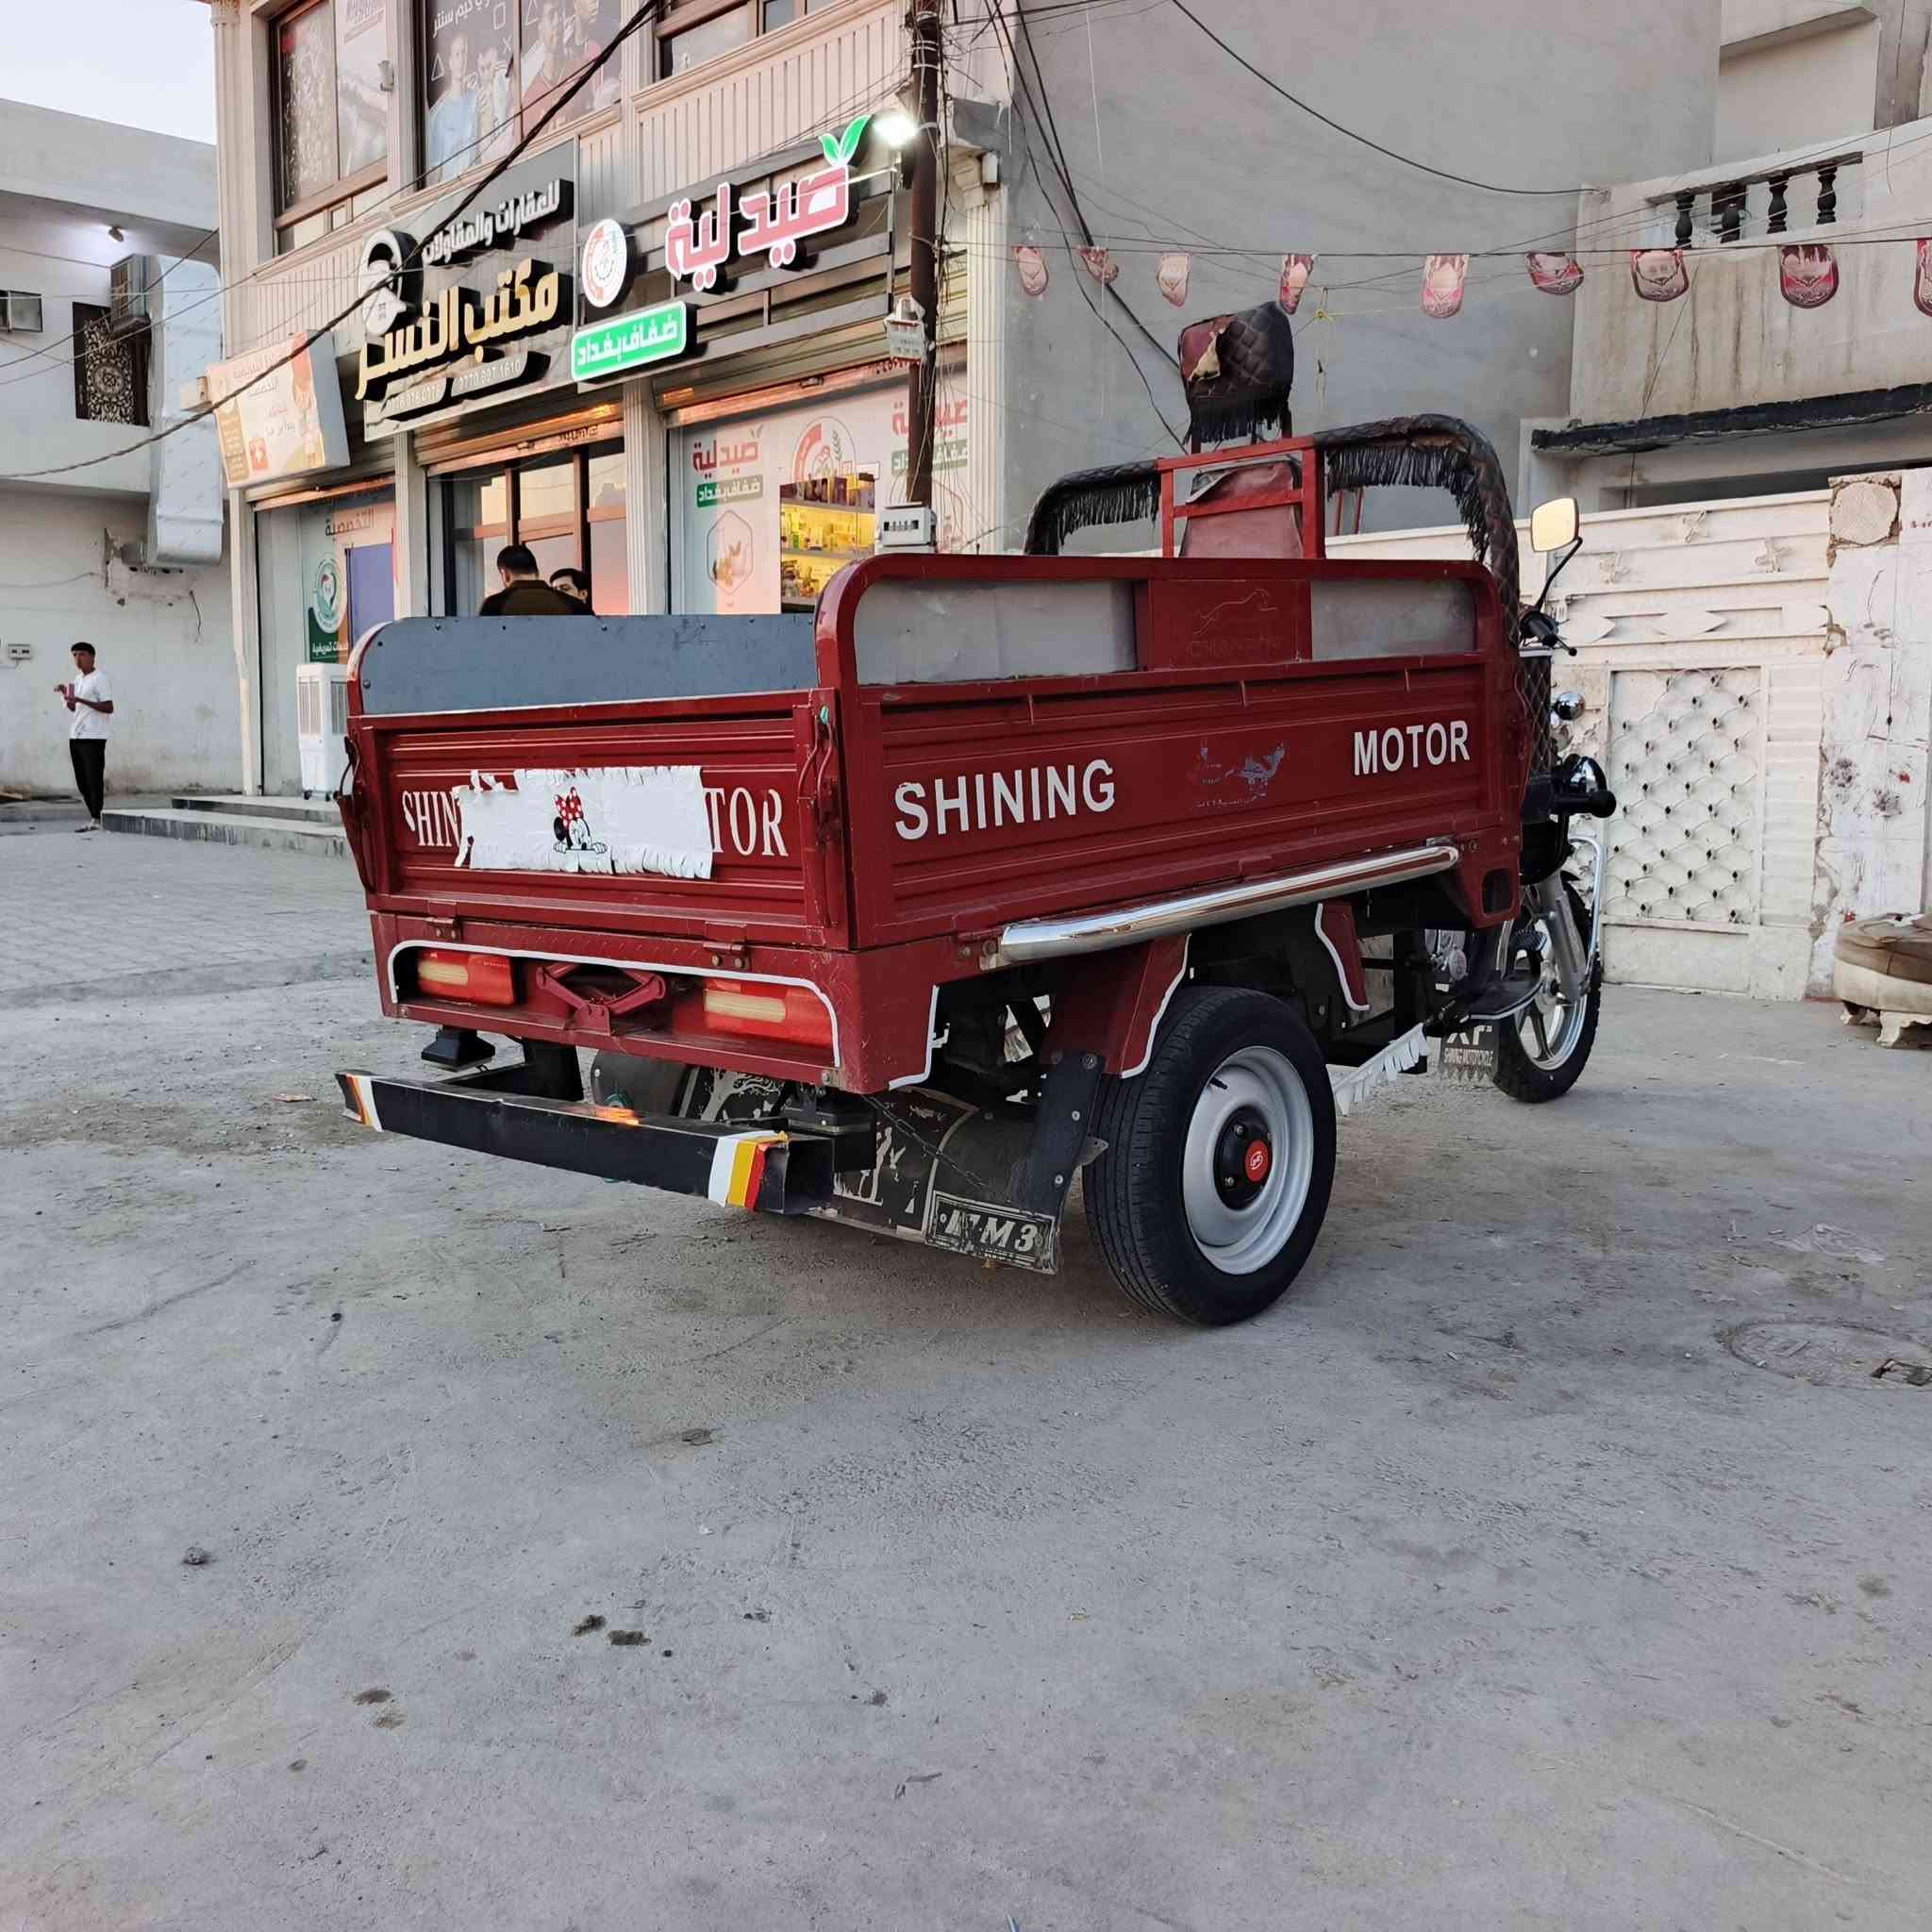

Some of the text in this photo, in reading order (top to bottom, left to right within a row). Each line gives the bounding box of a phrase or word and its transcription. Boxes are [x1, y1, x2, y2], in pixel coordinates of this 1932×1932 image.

[495, 178, 561, 236] للعقارات
[664, 163, 851, 292] صيدلية
[355, 258, 559, 400] مكتب النسر
[576, 314, 678, 367] ضفاف بغداد
[692, 440, 759, 479] صيدلية
[698, 477, 761, 502] ضفاف بغداد
[1353, 719, 1470, 775] MOTOR
[704, 786, 790, 859] TOR
[894, 758, 1116, 841] SHINING
